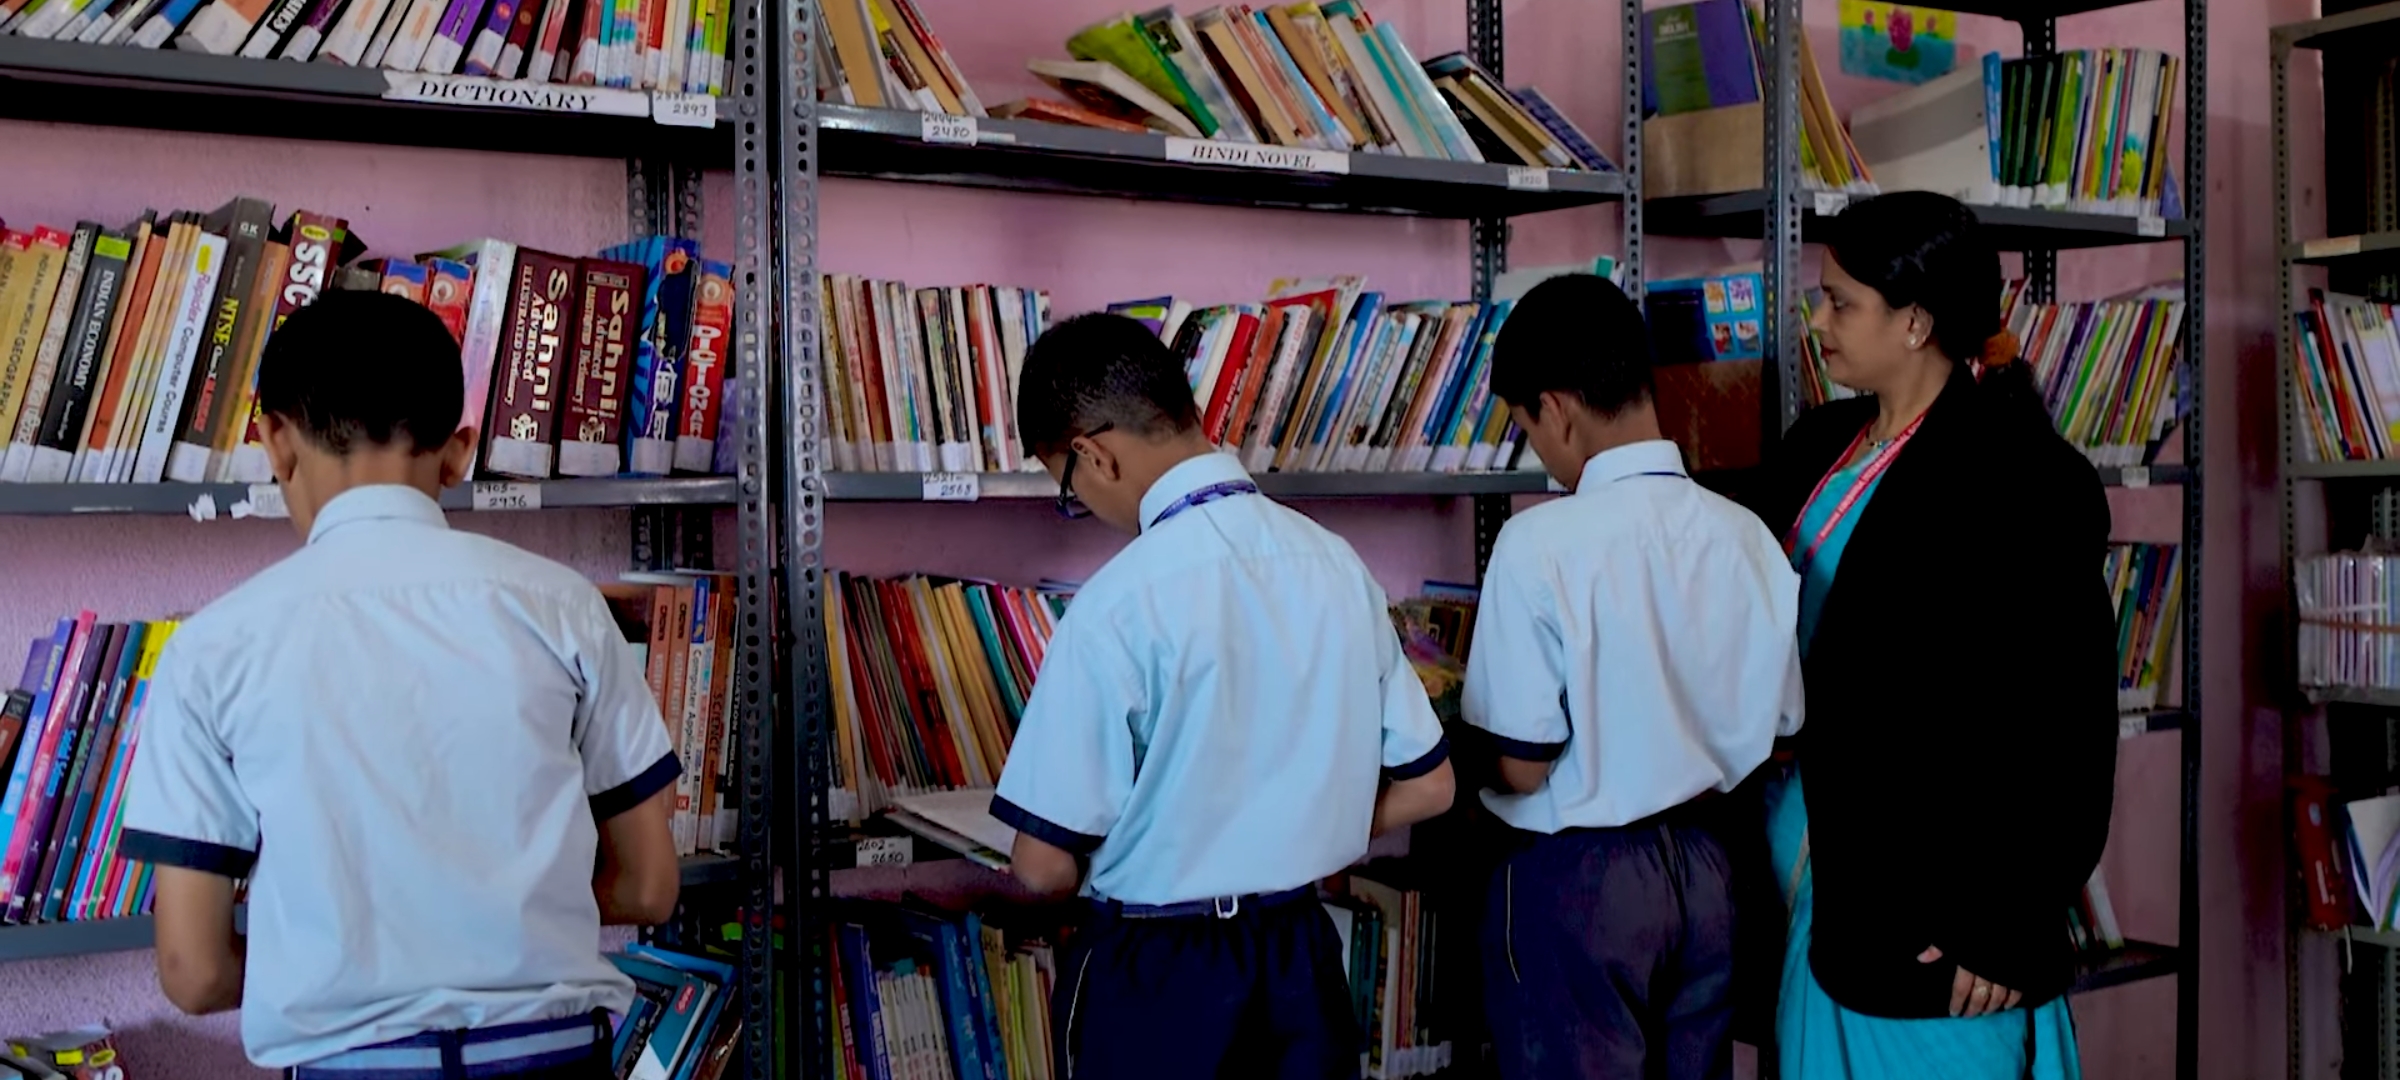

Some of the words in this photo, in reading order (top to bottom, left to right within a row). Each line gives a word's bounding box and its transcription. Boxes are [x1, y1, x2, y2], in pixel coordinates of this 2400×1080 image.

[419, 81, 595, 111] DICTIONARY
[673, 103, 707, 117] 2893
[932, 126, 970, 138] 2480
[1192, 144, 1249, 163] HINDI
[1254, 151, 1316, 169] NOVEL
[93, 270, 115, 319] INDIAN
[285, 241, 326, 308] SSC
[214, 297, 238, 346] NTSE
[514, 266, 532, 348] ILLUSTRATED
[523, 294, 544, 380] Advanced
[73, 320, 101, 389] ECONOMY
[169, 327, 194, 391] Computer
[534, 269, 567, 410] Sahni
[591, 316, 608, 378] Advanced
[600, 290, 629, 410] Sahni
[0, 337, 25, 415] GEOGRAPHY
[156, 390, 177, 434] Course
[489, 495, 527, 508] 2936
[687, 649, 702, 707] Computer
[680, 712, 697, 784] Applications
[710, 692, 725, 756] SCIENCE
